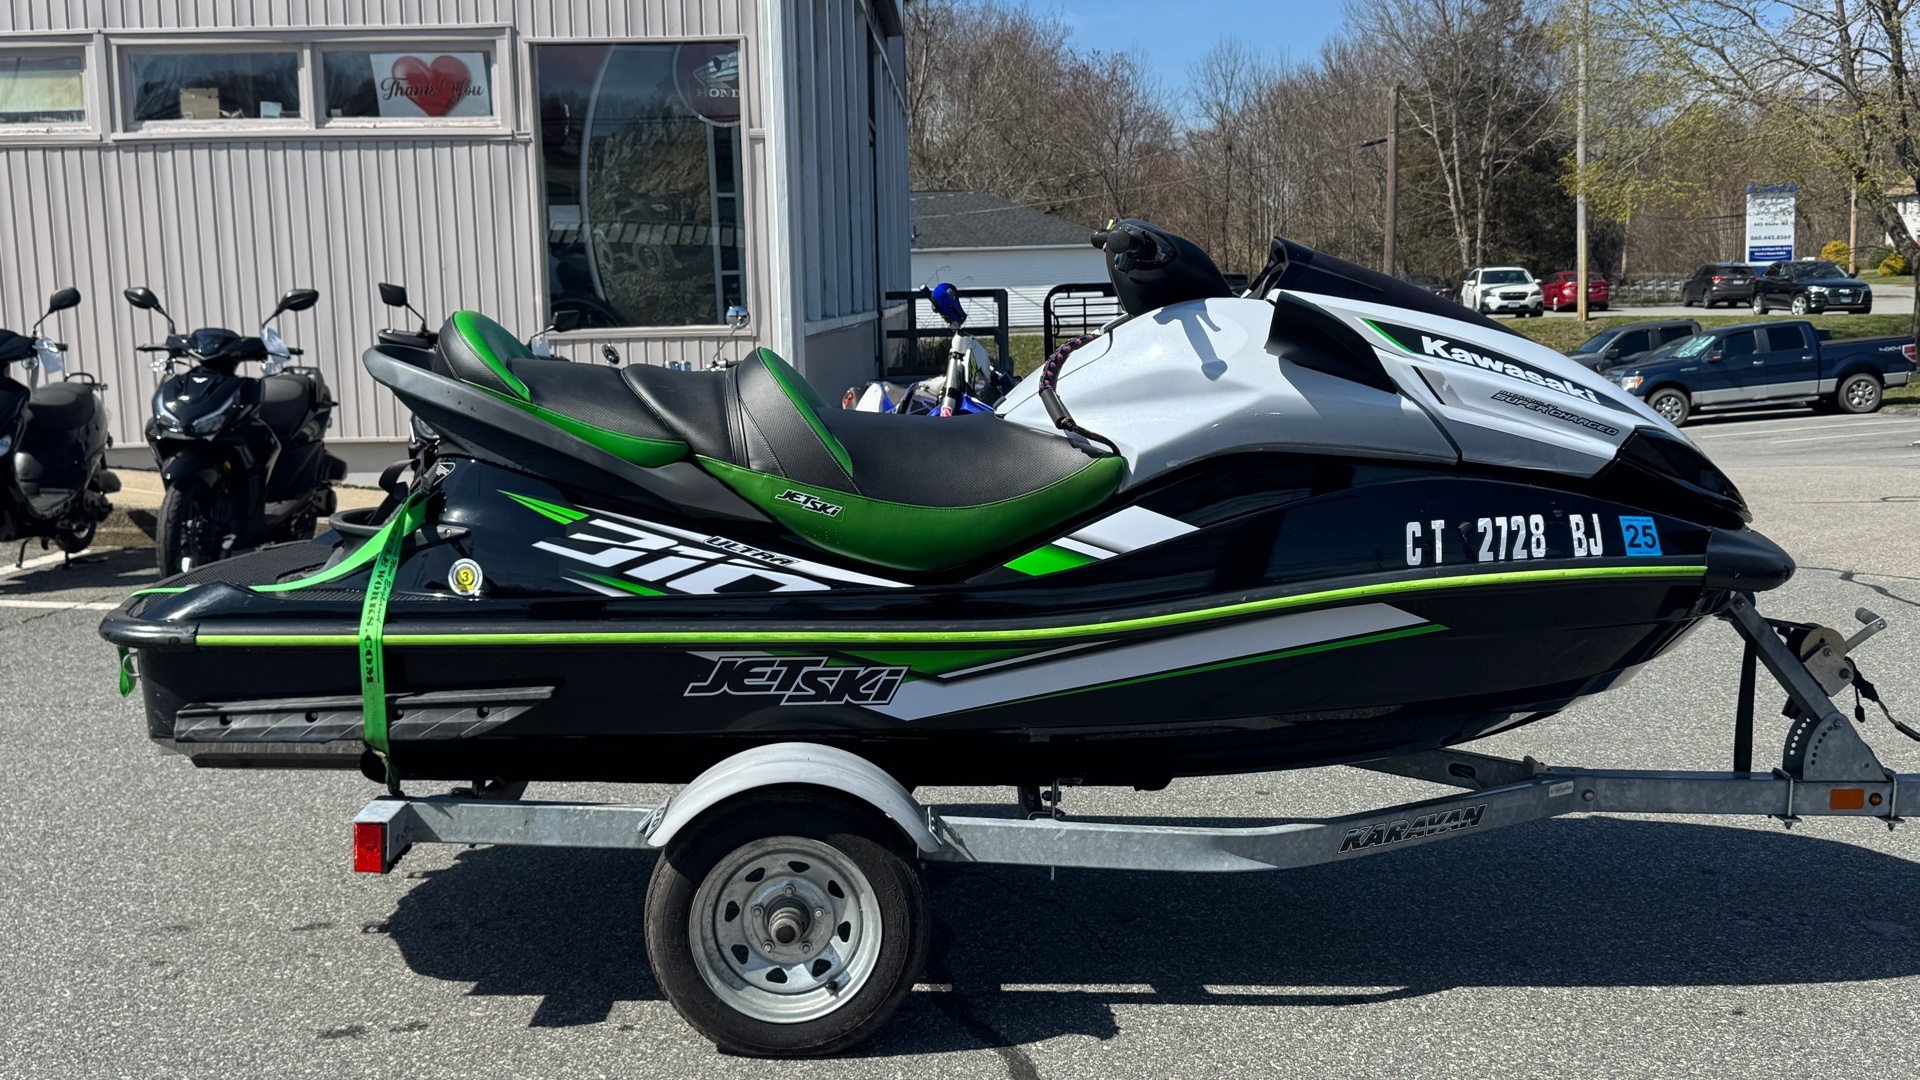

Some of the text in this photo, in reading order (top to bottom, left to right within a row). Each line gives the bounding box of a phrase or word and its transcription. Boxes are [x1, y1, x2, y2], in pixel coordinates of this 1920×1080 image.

[381, 77, 484, 102] Thank You
[697, 88, 740, 98] HOND
[1421, 335, 1601, 405] Kawasaki
[1477, 514, 1547, 562] 2728
[1569, 513, 1604, 558] BJ
[1625, 524, 1657, 549] 25
[703, 535, 800, 567] ULTRA
[462, 571, 470, 582] 3
[1337, 804, 1489, 854] KARAVAN
